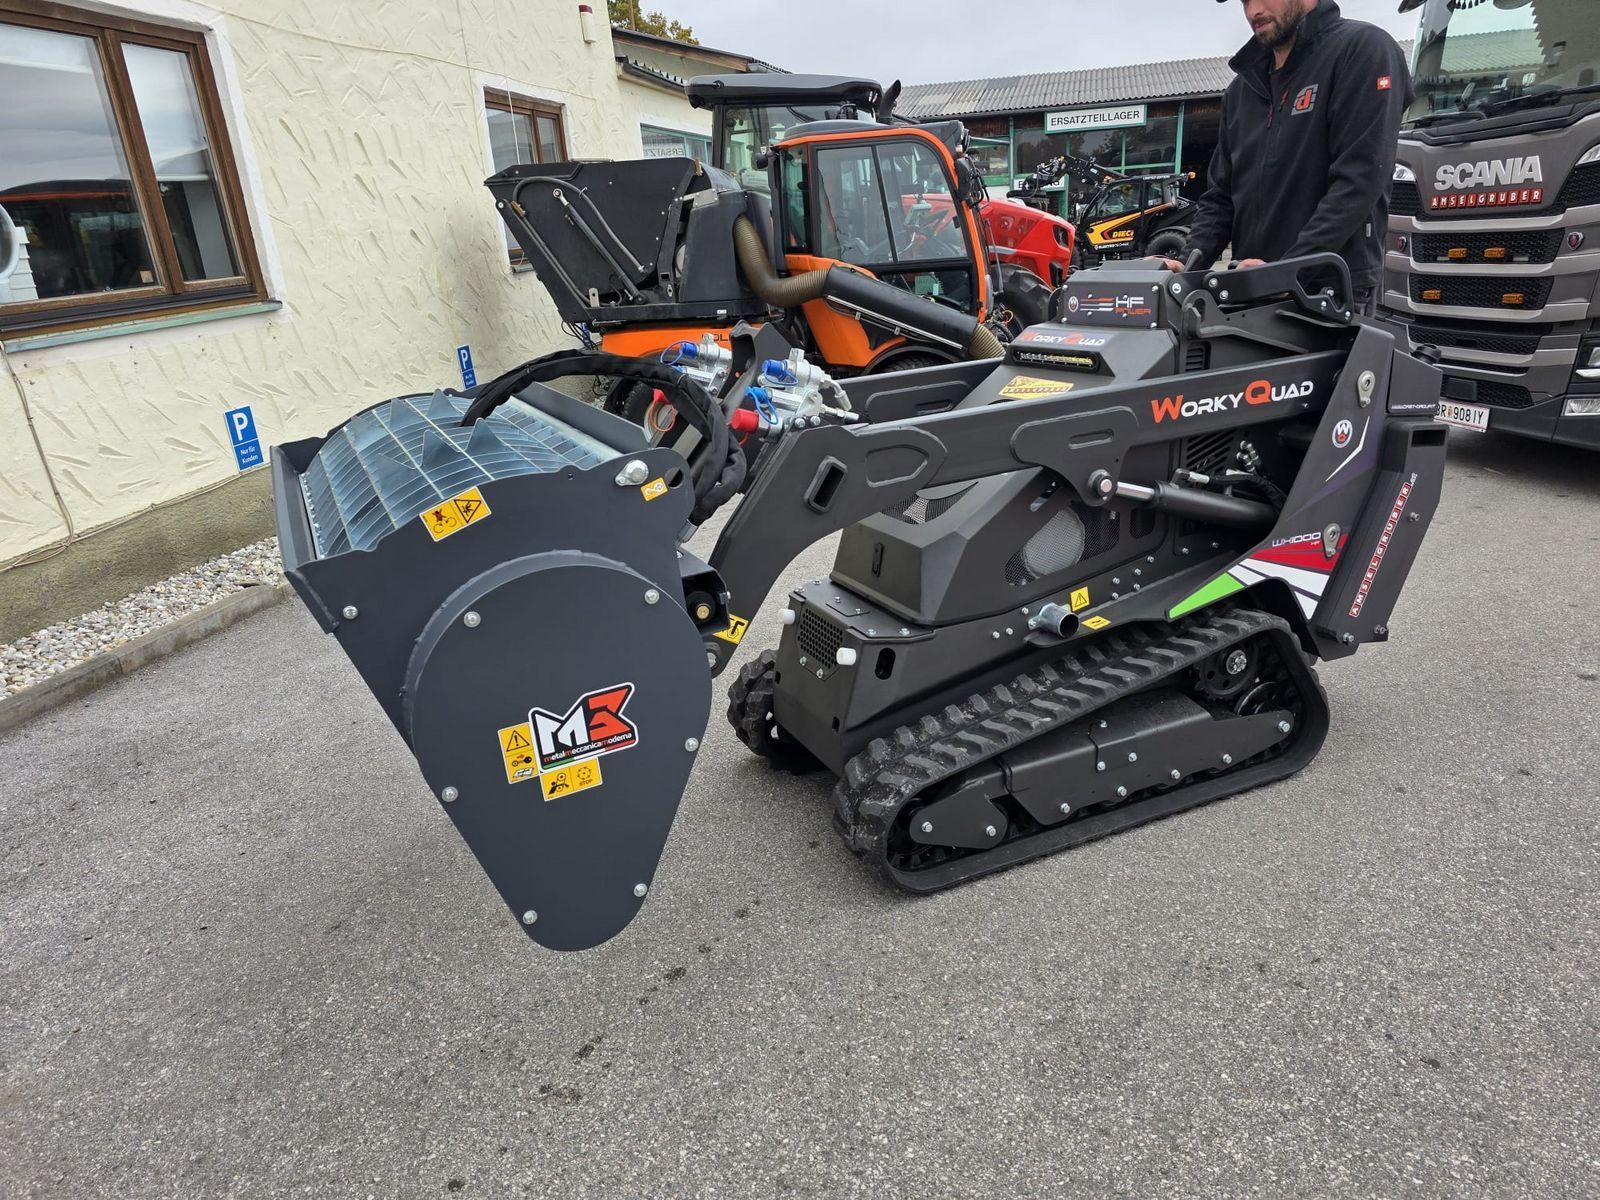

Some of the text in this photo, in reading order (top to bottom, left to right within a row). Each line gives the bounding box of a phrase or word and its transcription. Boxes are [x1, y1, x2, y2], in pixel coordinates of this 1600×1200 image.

[1051, 110, 1140, 126] ERSATZTEILLAGER
[1434, 155, 1543, 191] SCANIA
[1431, 190, 1541, 208] AMSELGRUBER
[1116, 297, 1144, 308] HF
[461, 349, 468, 369] P
[232, 412, 248, 441] P
[248, 445, 256, 453] für
[242, 455, 259, 464] Kunden
